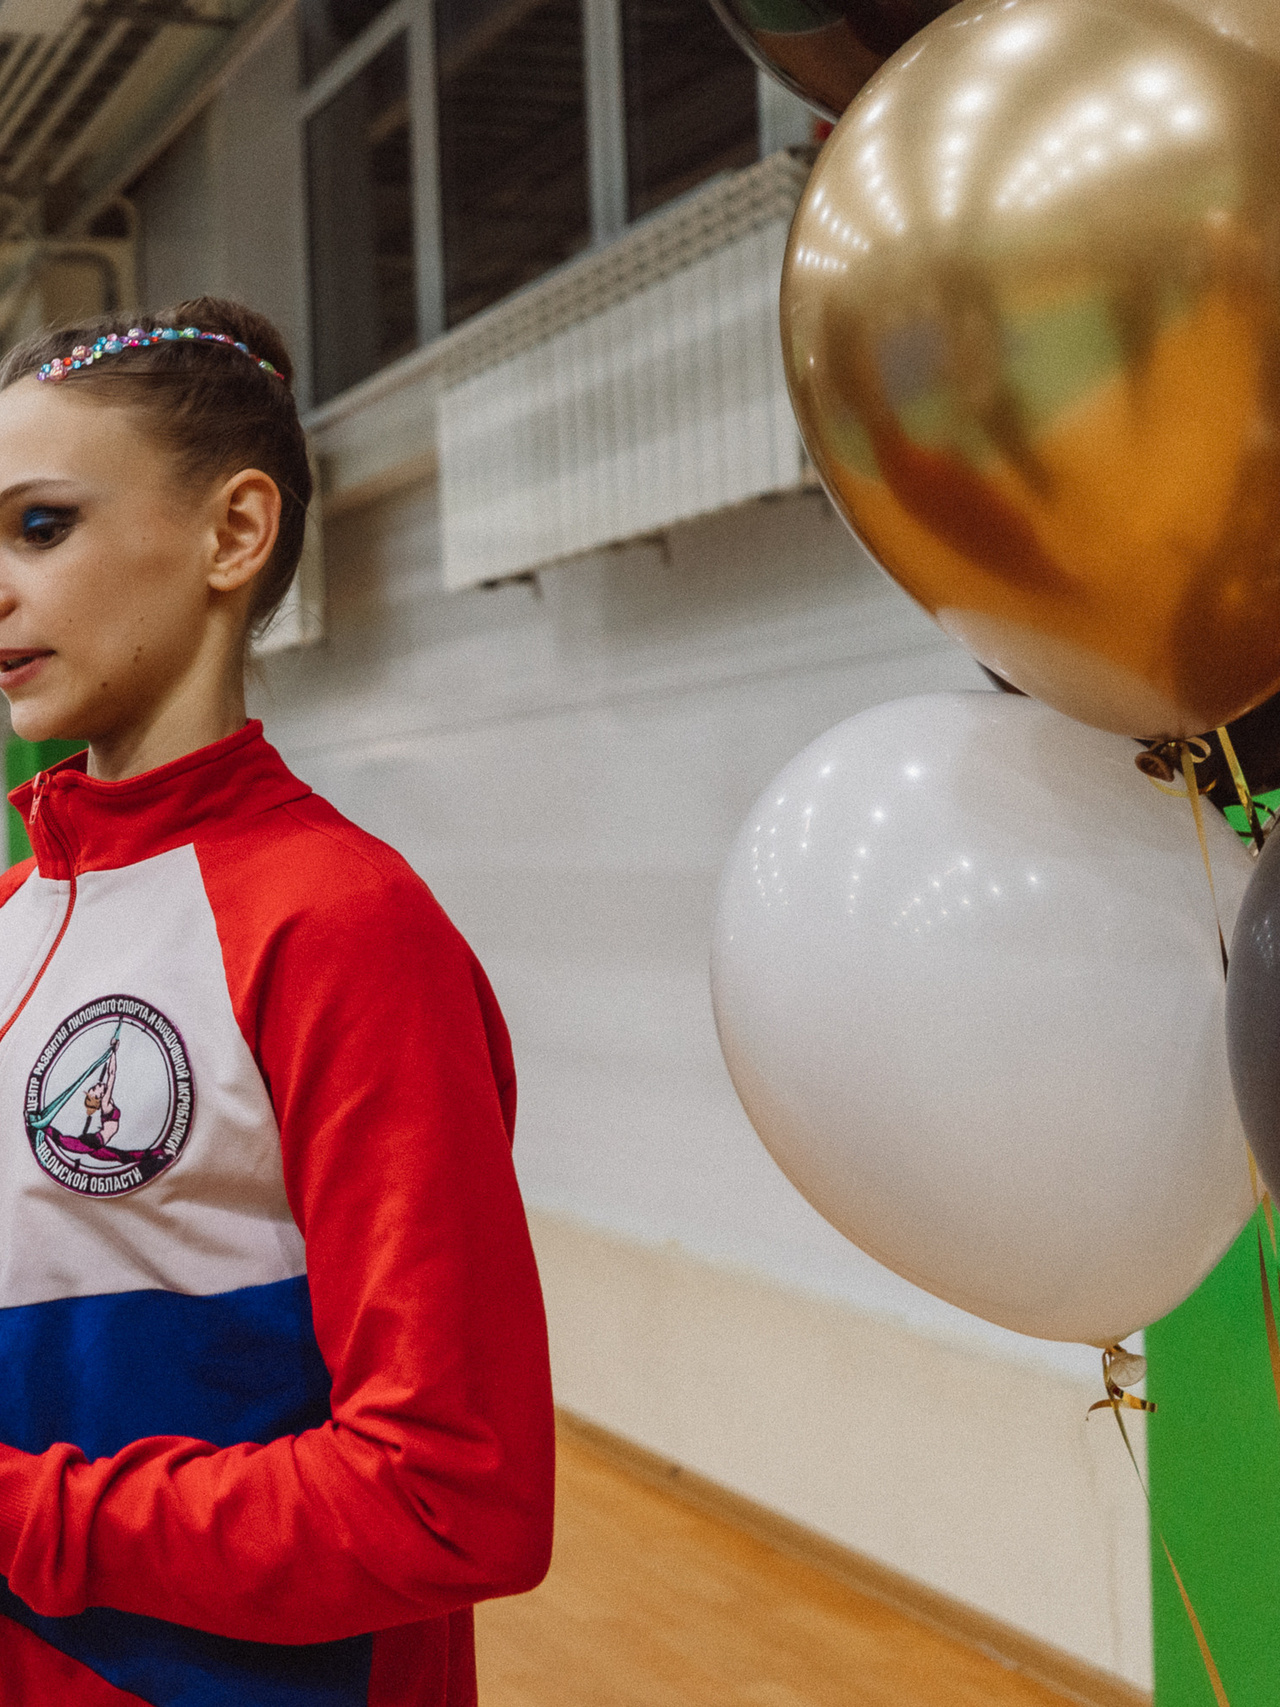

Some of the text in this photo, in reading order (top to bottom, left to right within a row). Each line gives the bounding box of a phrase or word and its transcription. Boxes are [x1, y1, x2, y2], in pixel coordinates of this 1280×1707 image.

[27, 999, 191, 1152] ЦЕНТР РАЗВИТИЯ ПИЛОННОГО СПОРТА И ВОЗДУШНОЙ АКРОБАТИКИ
[46, 1155, 89, 1191] ОМСКОЙ
[90, 1166, 143, 1193] ОБЛАСТИ
